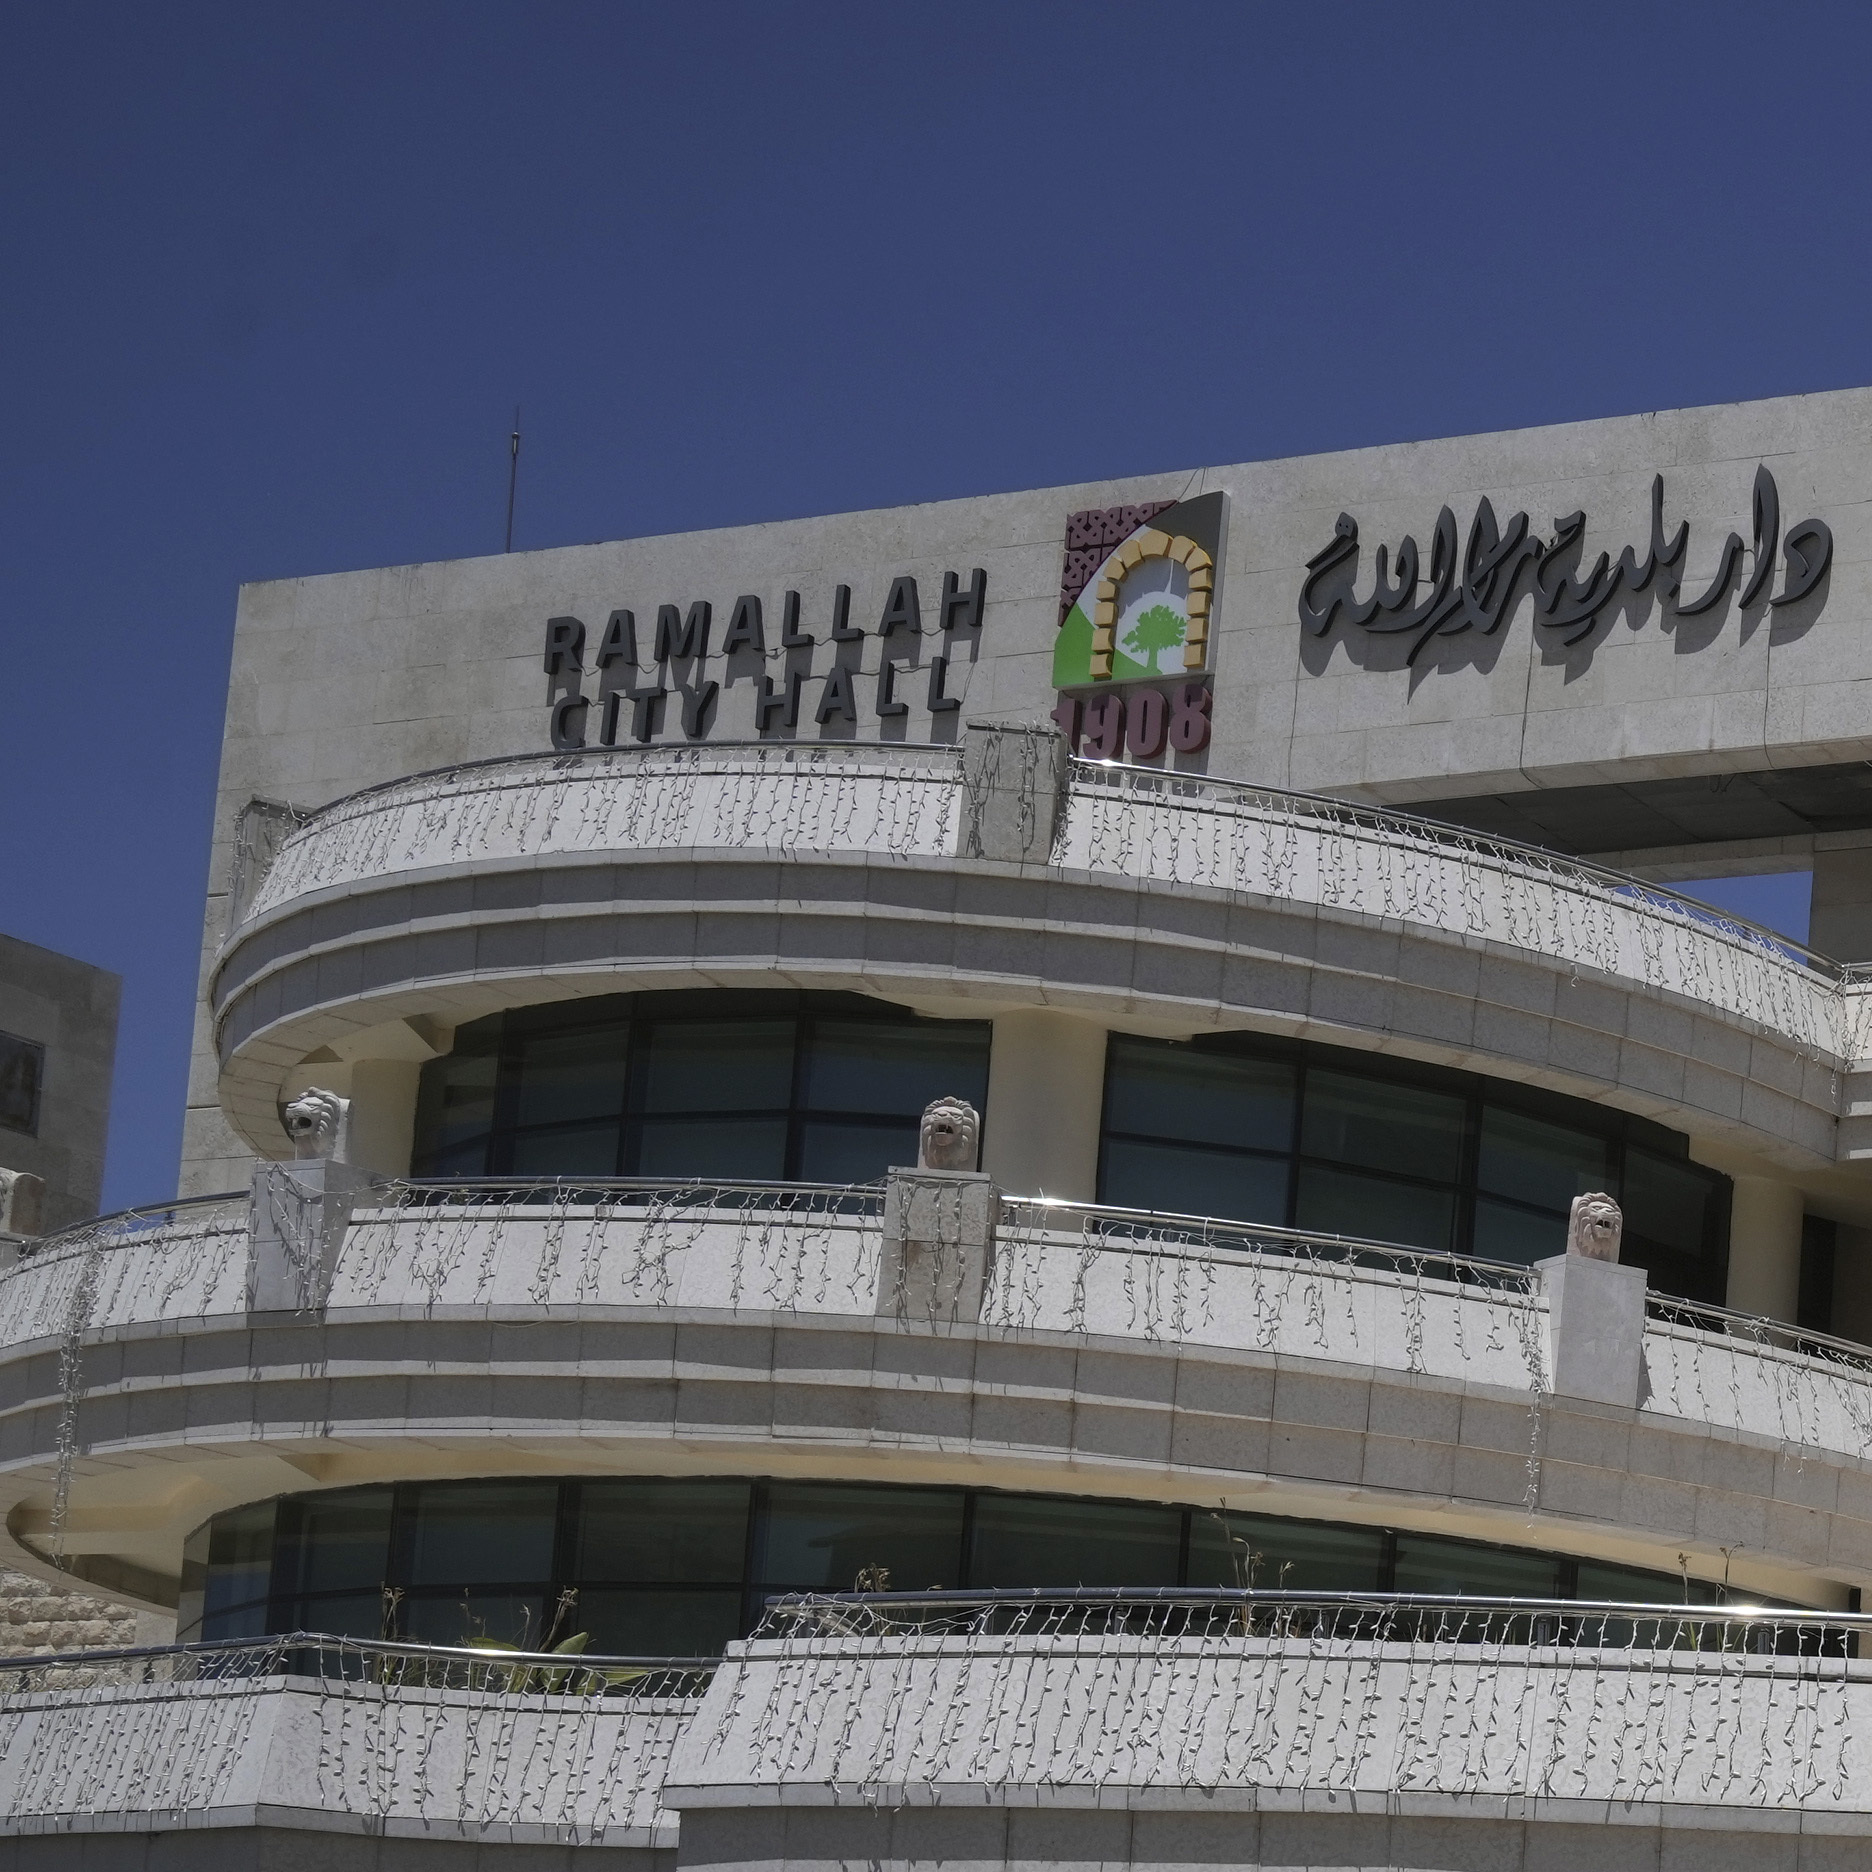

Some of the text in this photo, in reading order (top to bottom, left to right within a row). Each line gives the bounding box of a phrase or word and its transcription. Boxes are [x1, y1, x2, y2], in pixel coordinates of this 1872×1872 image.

[1537, 472, 1690, 647] بلدية
[1674, 463, 1834, 617] دار
[544, 567, 987, 676] RAMALLAH
[550, 656, 963, 751] CITY HALL
[1051, 684, 1212, 760] 1908
